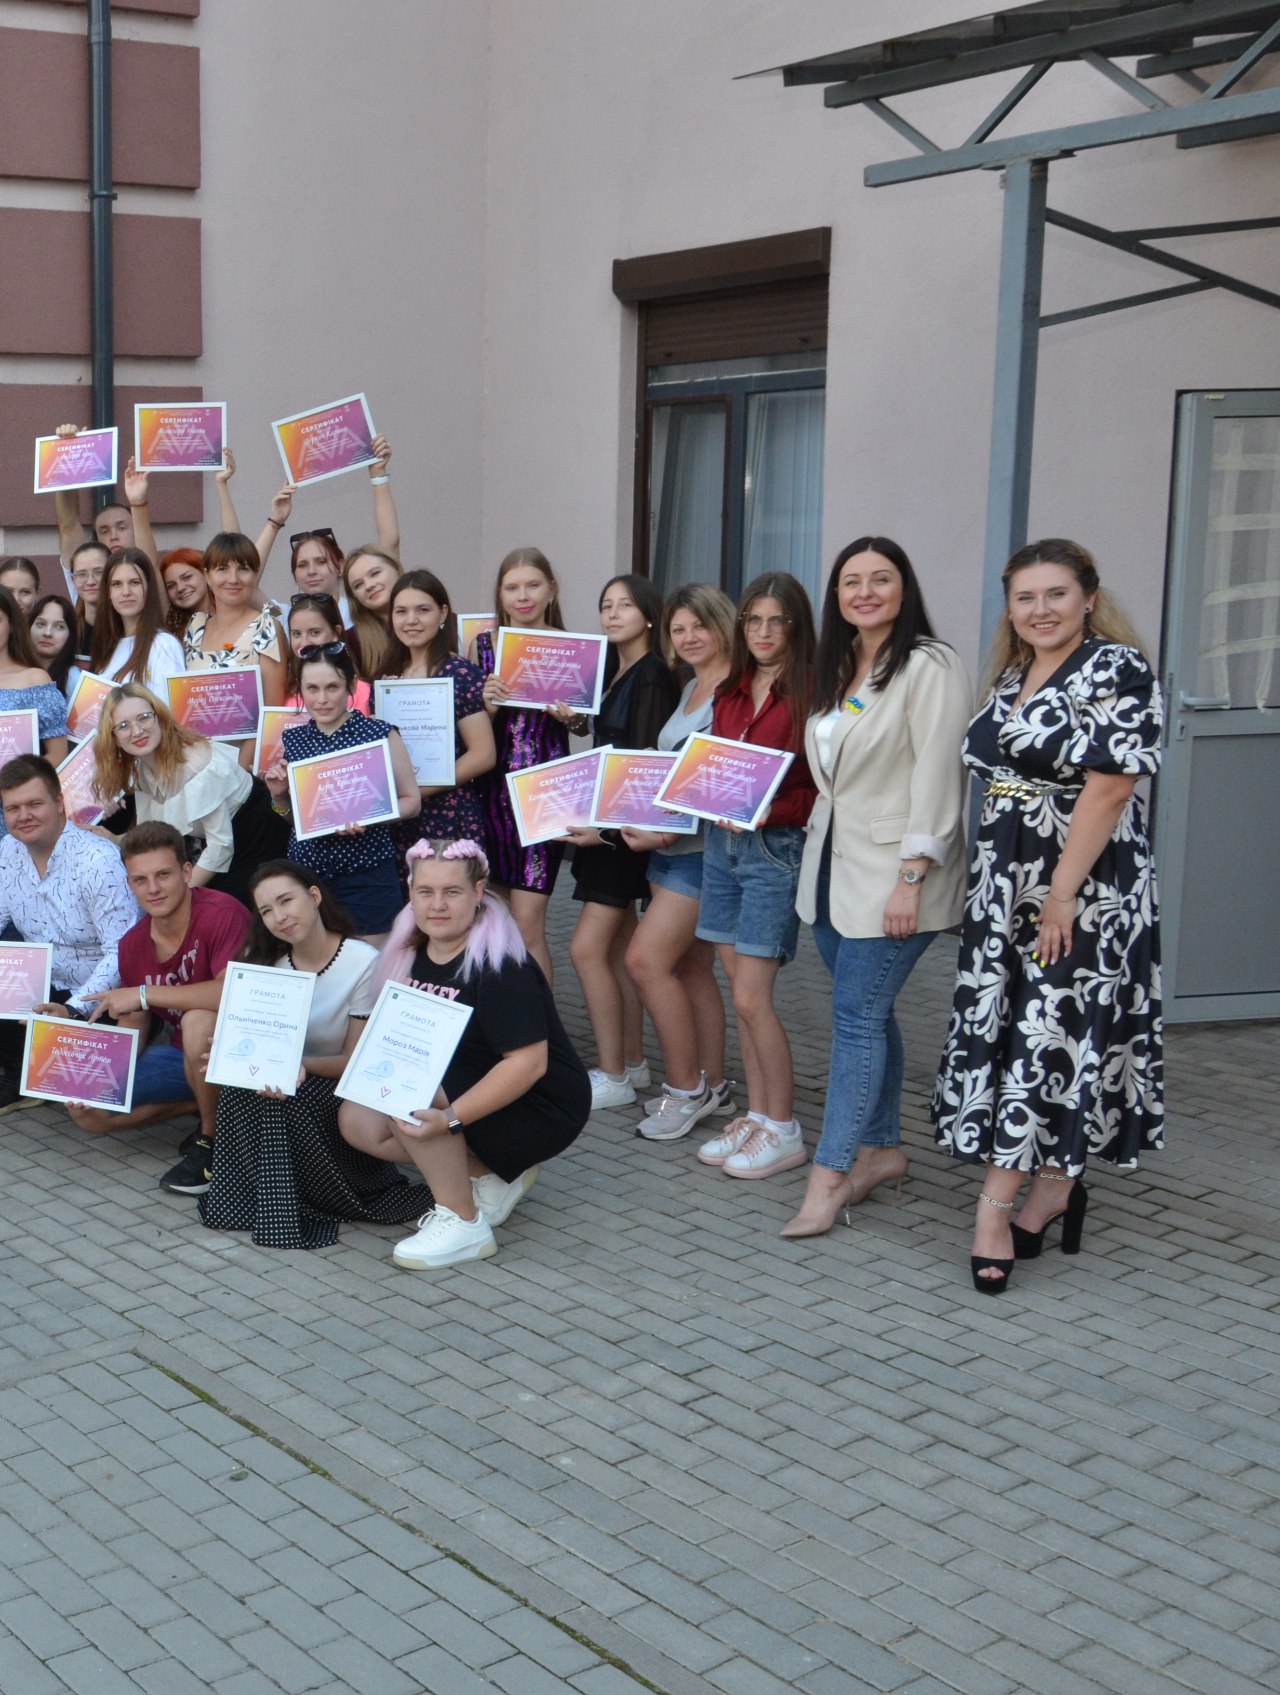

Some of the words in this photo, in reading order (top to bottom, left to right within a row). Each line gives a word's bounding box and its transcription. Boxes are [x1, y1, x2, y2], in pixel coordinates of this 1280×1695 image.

[301, 416, 343, 434] СЕРТИФІКАТ
[58, 443, 94, 452] СЕРТИФІКАТ
[526, 646, 575, 656] СЕРТИФІКАТ
[191, 684, 236, 692] СЕРТИФІКАТ
[709, 755, 757, 770] СЕРТИФІКАТ
[317, 763, 363, 779] СЕРТИФІКАТ
[540, 769, 588, 787] СЕРТИФІКАТ
[227, 1013, 273, 1027] Ольніченко
[274, 1019, 298, 1032] Орина
[57, 1036, 108, 1049] СЕРТИФІКАТ
[381, 1034, 408, 1051] Мороз
[408, 1042, 431, 1058] Марія
